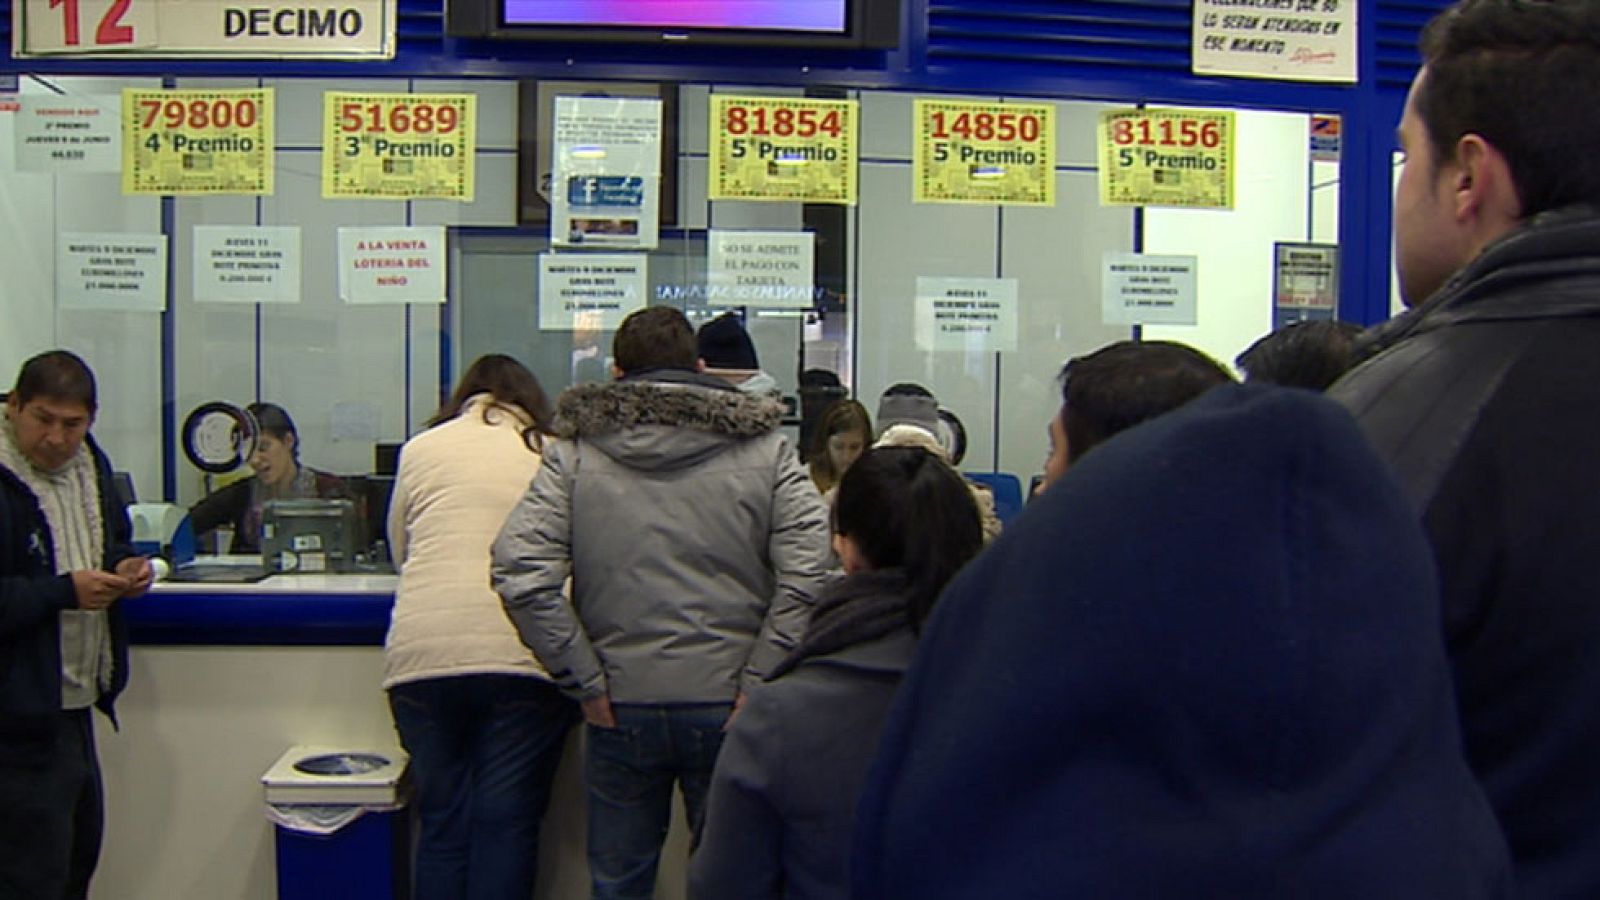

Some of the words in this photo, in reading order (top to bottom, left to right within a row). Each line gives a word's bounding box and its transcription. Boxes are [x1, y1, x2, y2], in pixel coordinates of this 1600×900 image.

[224, 8, 363, 37] DECIMO
[141, 100, 257, 128] 79800
[341, 104, 458, 134] 51689
[727, 107, 842, 138] 81854
[931, 111, 1040, 142] 14850
[1113, 119, 1220, 148] 81156
[173, 133, 254, 152] Premio
[374, 137, 455, 157] Premio
[758, 141, 837, 161] Premio
[960, 146, 1036, 165] Premio
[1144, 150, 1217, 170] Premio
[357, 241, 366, 250] A
[368, 241, 384, 250] LA
[387, 241, 427, 250] VENTA
[408, 258, 430, 268] DEL
